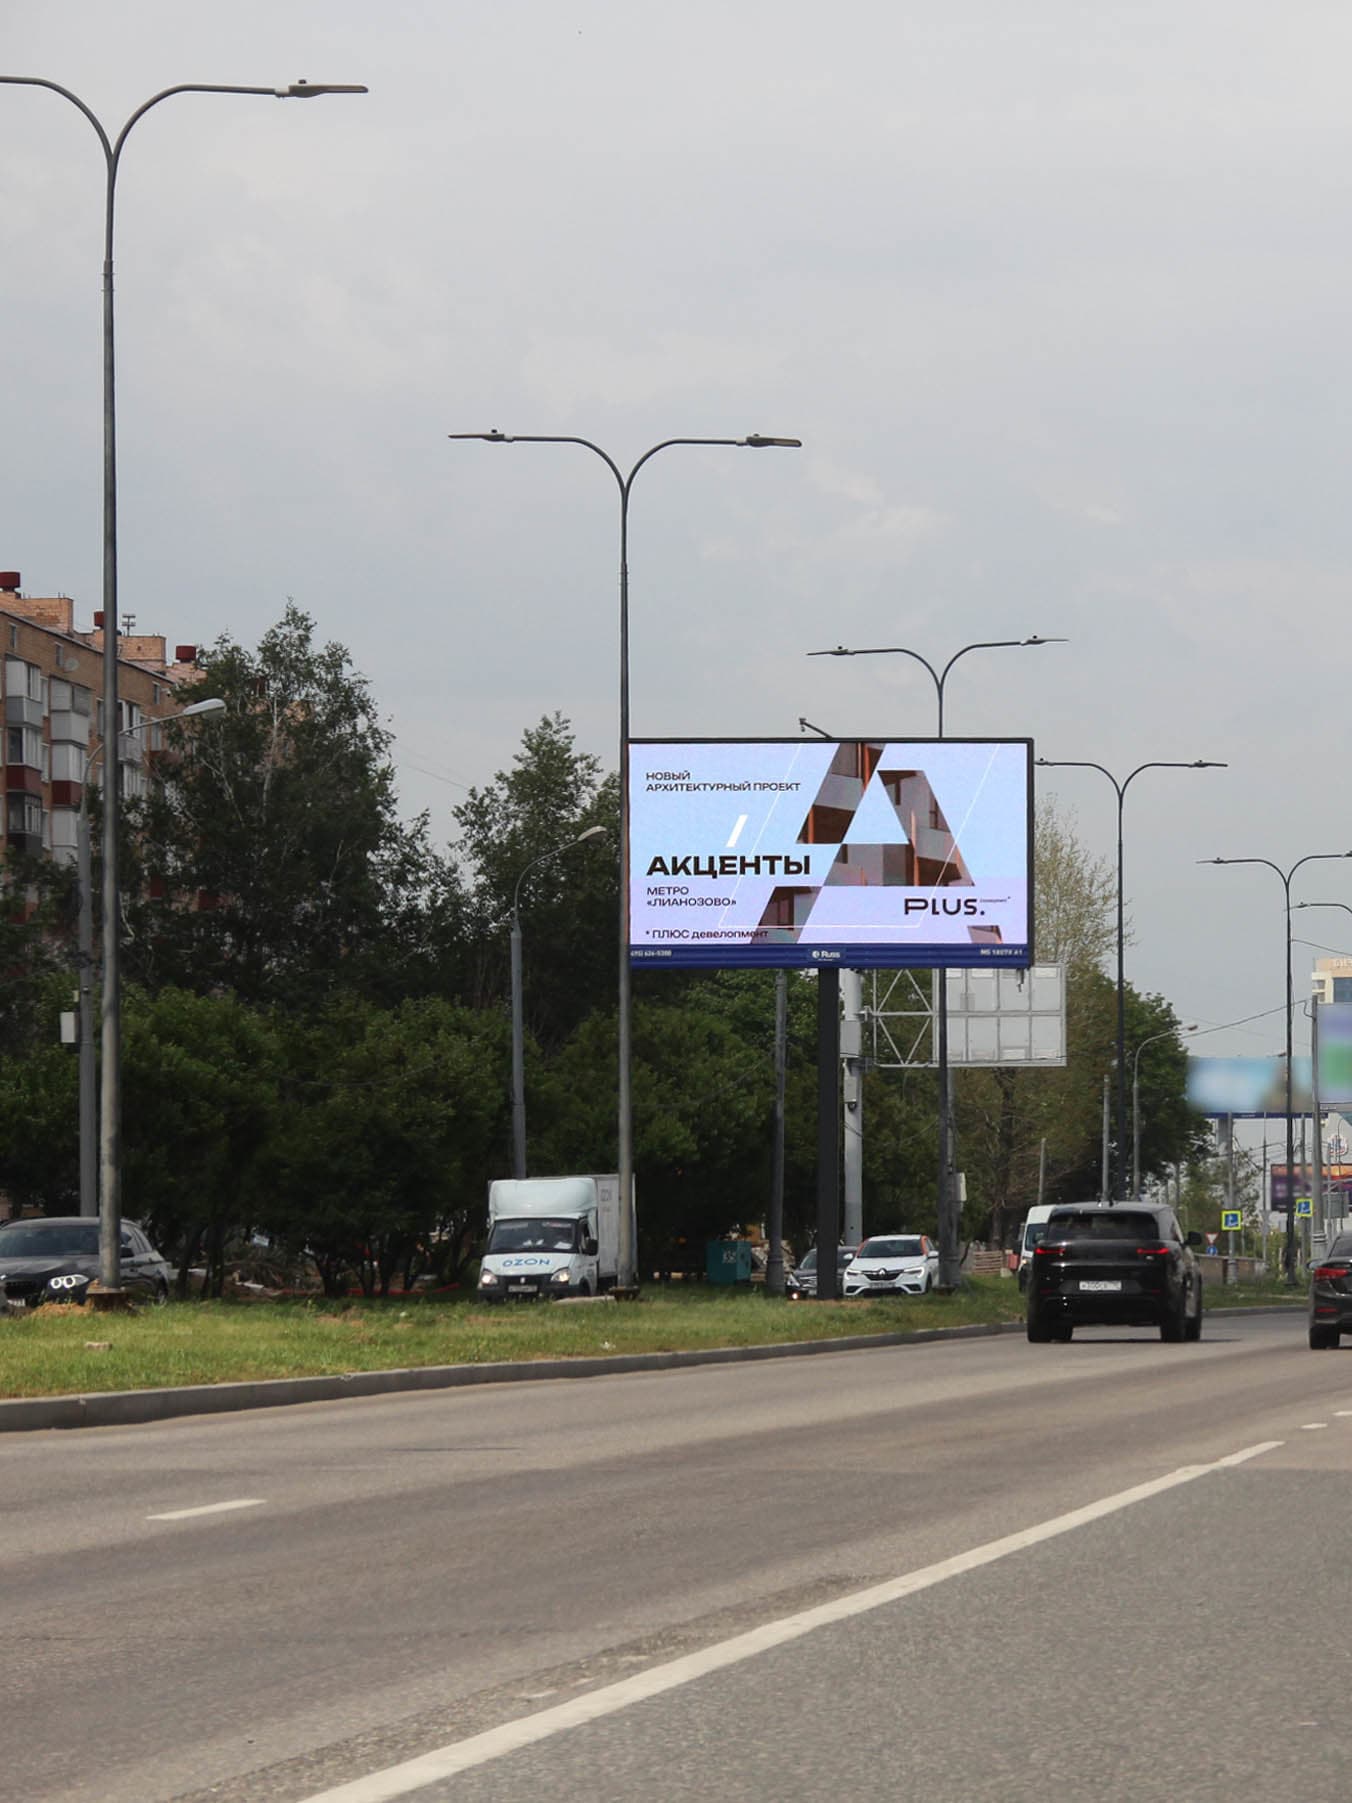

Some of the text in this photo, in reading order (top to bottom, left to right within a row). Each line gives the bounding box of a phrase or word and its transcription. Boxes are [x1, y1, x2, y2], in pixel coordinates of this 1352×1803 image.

[646, 770, 691, 780] НОВЫЙ
[646, 781, 801, 792] АРХИТЕКТУРНЫЙ ПРОЕКТ
[646, 855, 811, 879] АКЦЕНТЫ
[646, 886, 690, 896] МЕТРО
[646, 896, 737, 907] «ЛИАНОЗОВО»
[652, 929, 690, 939] ПЛЮС
[502, 1258, 550, 1267] OZON
